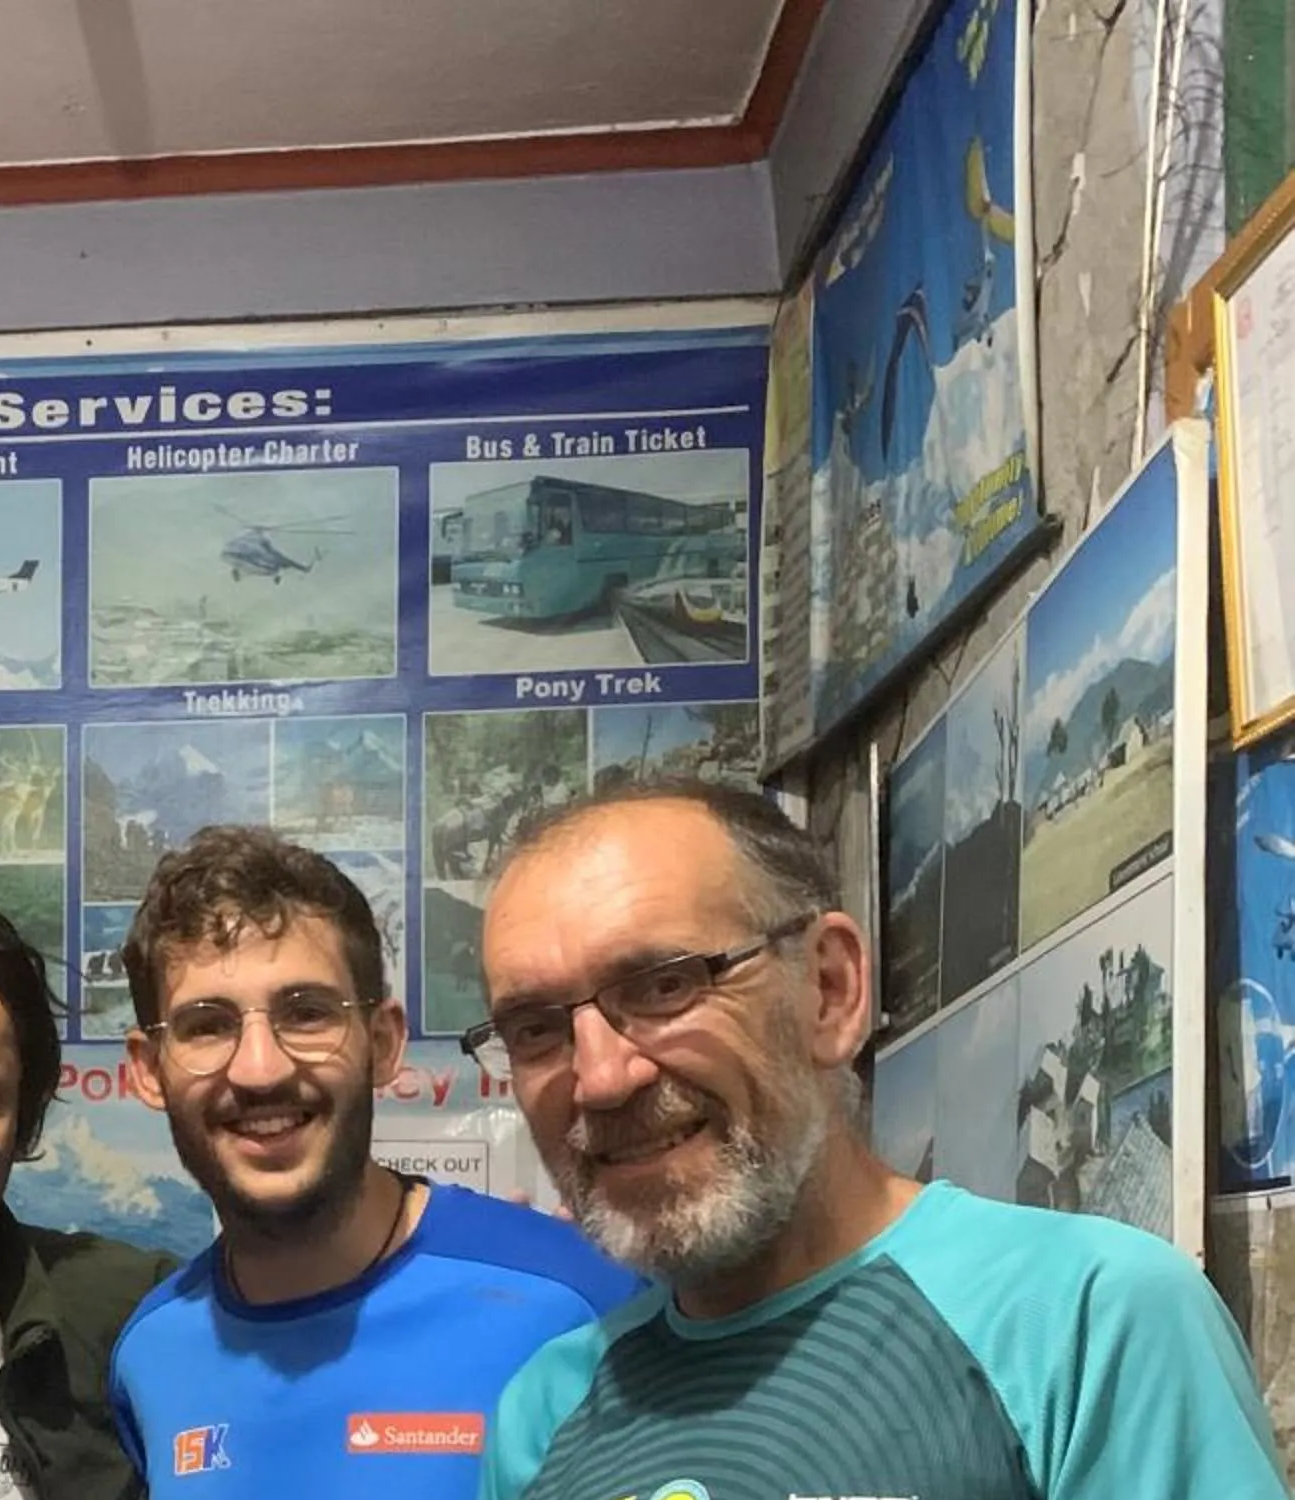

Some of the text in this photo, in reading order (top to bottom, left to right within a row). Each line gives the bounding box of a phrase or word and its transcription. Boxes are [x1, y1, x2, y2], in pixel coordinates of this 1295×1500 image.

[126, 438, 359, 471] Helicopter Charter
[465, 425, 706, 460] Bus & Train Ticket
[516, 671, 661, 702] Pony Trek
[183, 688, 291, 717] Trekking
[444, 1158, 482, 1172] OUT
[384, 1426, 479, 1445] Santander
